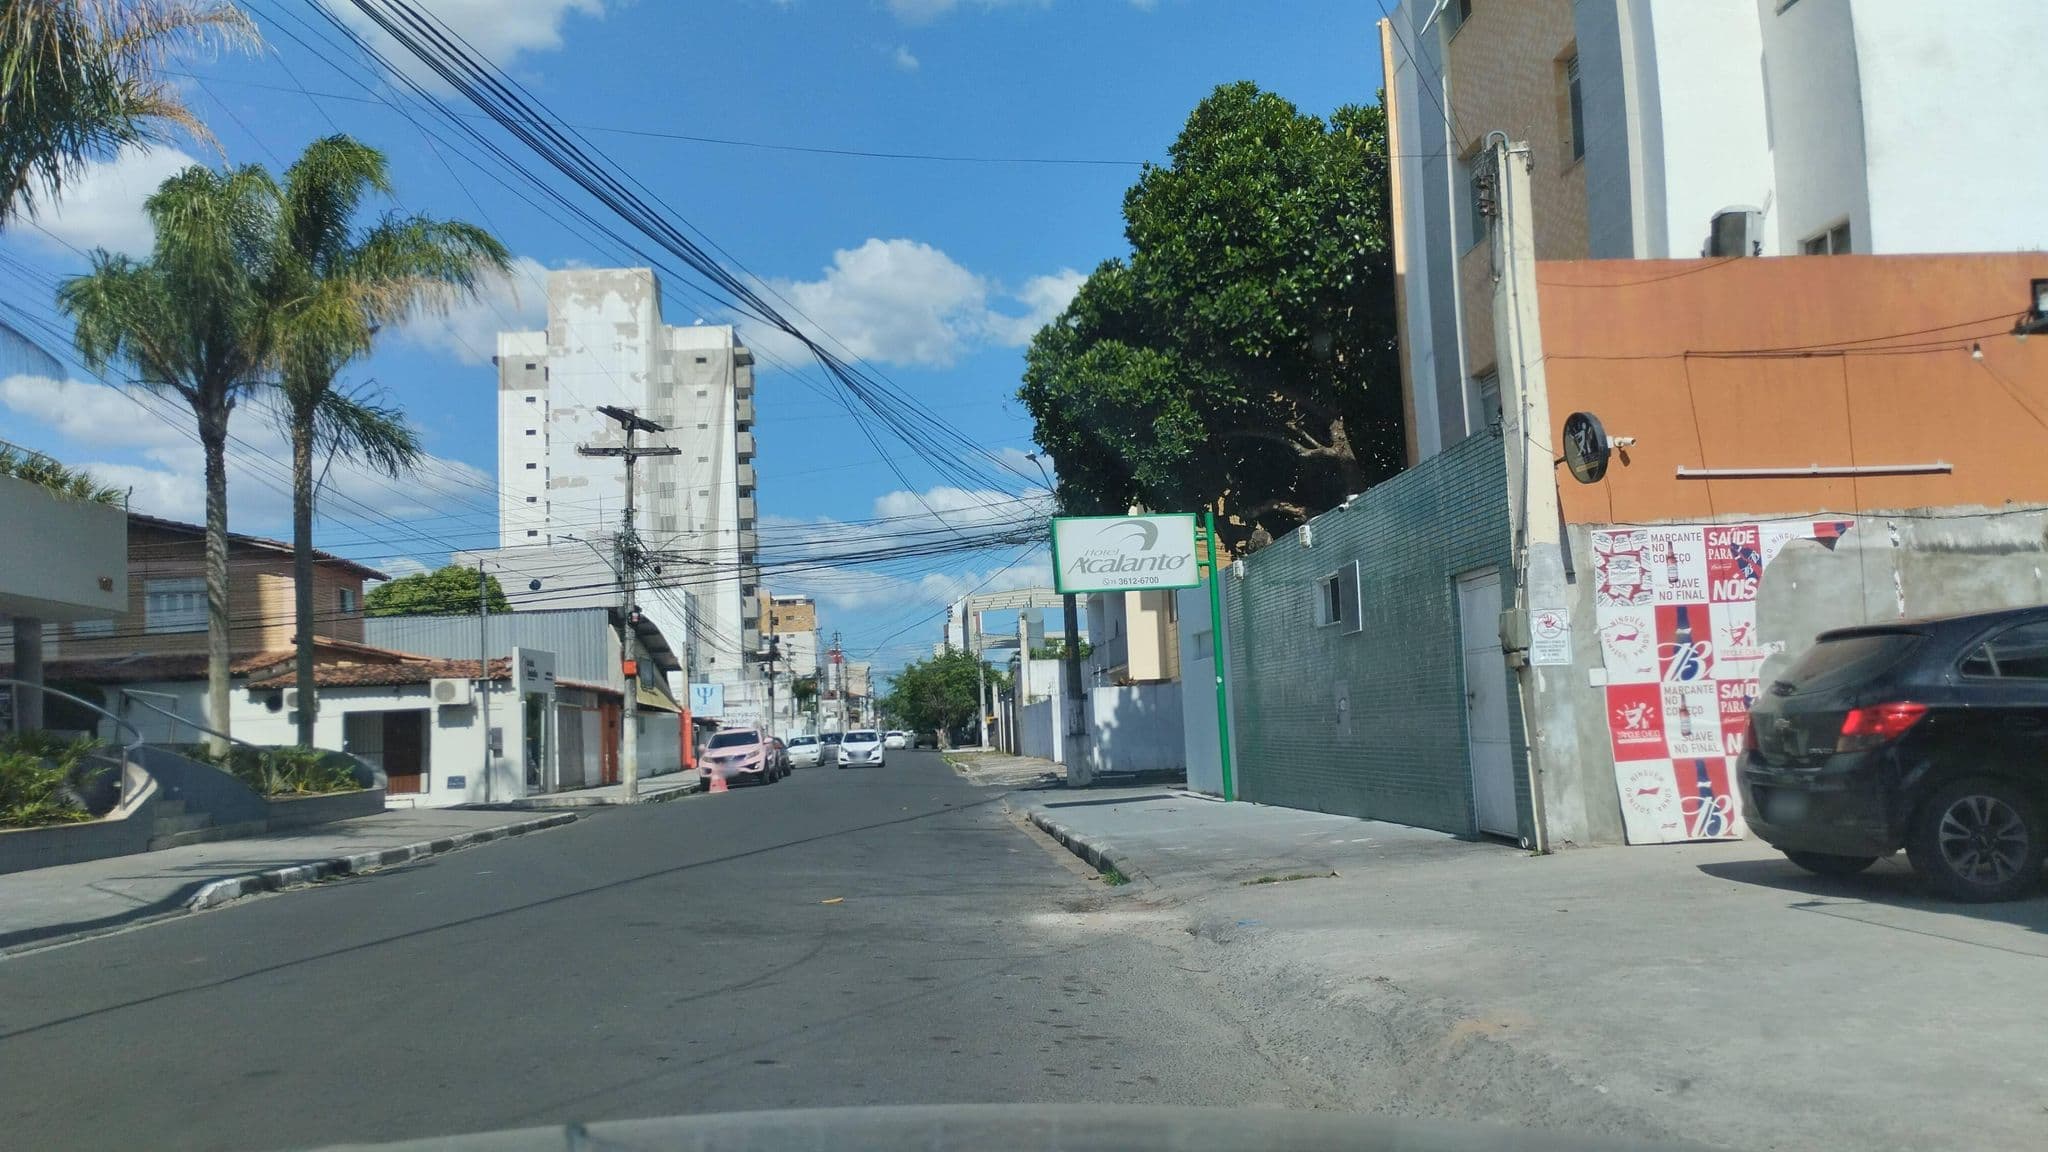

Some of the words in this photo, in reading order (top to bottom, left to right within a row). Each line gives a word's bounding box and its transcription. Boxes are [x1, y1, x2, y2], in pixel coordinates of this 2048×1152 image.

[1650, 532, 1702, 542] MARCANTE
[1709, 528, 1755, 546] SAÚDE
[1084, 548, 1120, 557] Hotel
[1652, 543, 1665, 552] NO
[1653, 553, 1691, 564] COEÇO
[1708, 548, 1733, 560] PARA
[1068, 553, 1191, 575] Acalanto
[1118, 576, 1160, 586] 3612-6700
[1713, 573, 1758, 601] NÓIS
[1659, 590, 1673, 601] NO
[1676, 589, 1705, 601] FINAL
[1664, 684, 1714, 695] MARCANTE
[1720, 679, 1760, 699] SAÚD
[1665, 696, 1678, 705] NO
[1666, 705, 1704, 717] COEÇO
[1720, 700, 1745, 713] PARA
[1674, 743, 1688, 753] NO
[1691, 742, 1720, 753] FINAL
